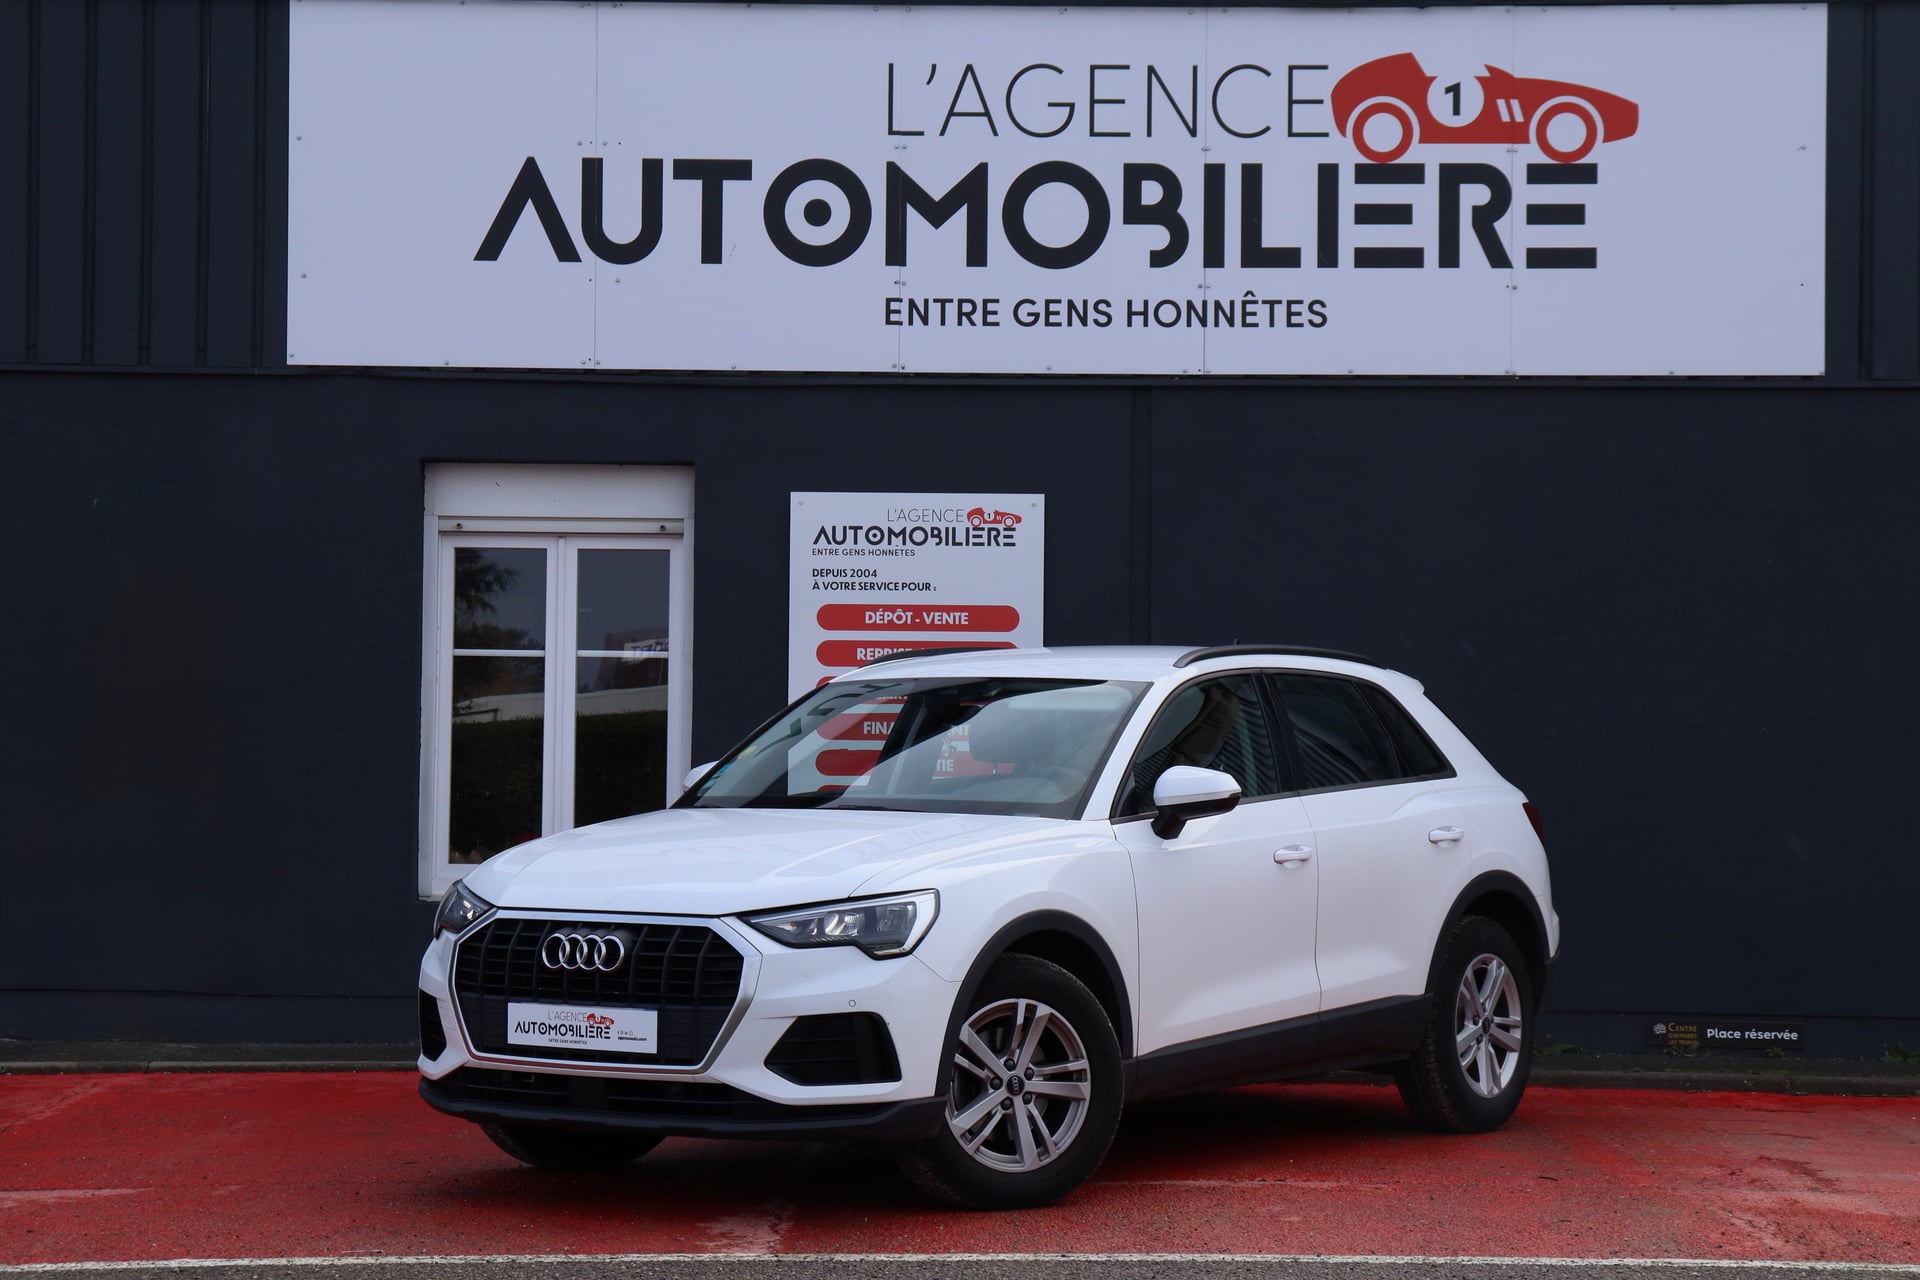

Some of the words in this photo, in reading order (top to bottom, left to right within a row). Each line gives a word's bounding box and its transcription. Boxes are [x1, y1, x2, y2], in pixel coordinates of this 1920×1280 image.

[1443, 81, 1462, 117] 1
[885, 297, 1001, 327] ENTRE
[1012, 298, 1113, 329] GENS
[1126, 290, 1328, 329] HONNÊTES
[812, 548, 840, 556] ENTRE
[841, 548, 866, 556] GENS
[867, 545, 916, 557] HONNÊTES
[812, 568, 848, 578] DEPUIS
[849, 568, 878, 578] 2004
[812, 579, 821, 591] À
[822, 581, 857, 591] VOTRE
[858, 581, 900, 591] SERVICE
[901, 582, 931, 592] POUR
[865, 609, 913, 625] DÉPÔT
[923, 612, 969, 625] VENTE
[1707, 1028, 1741, 1039] Place
[1745, 1029, 1799, 1040] réservée
